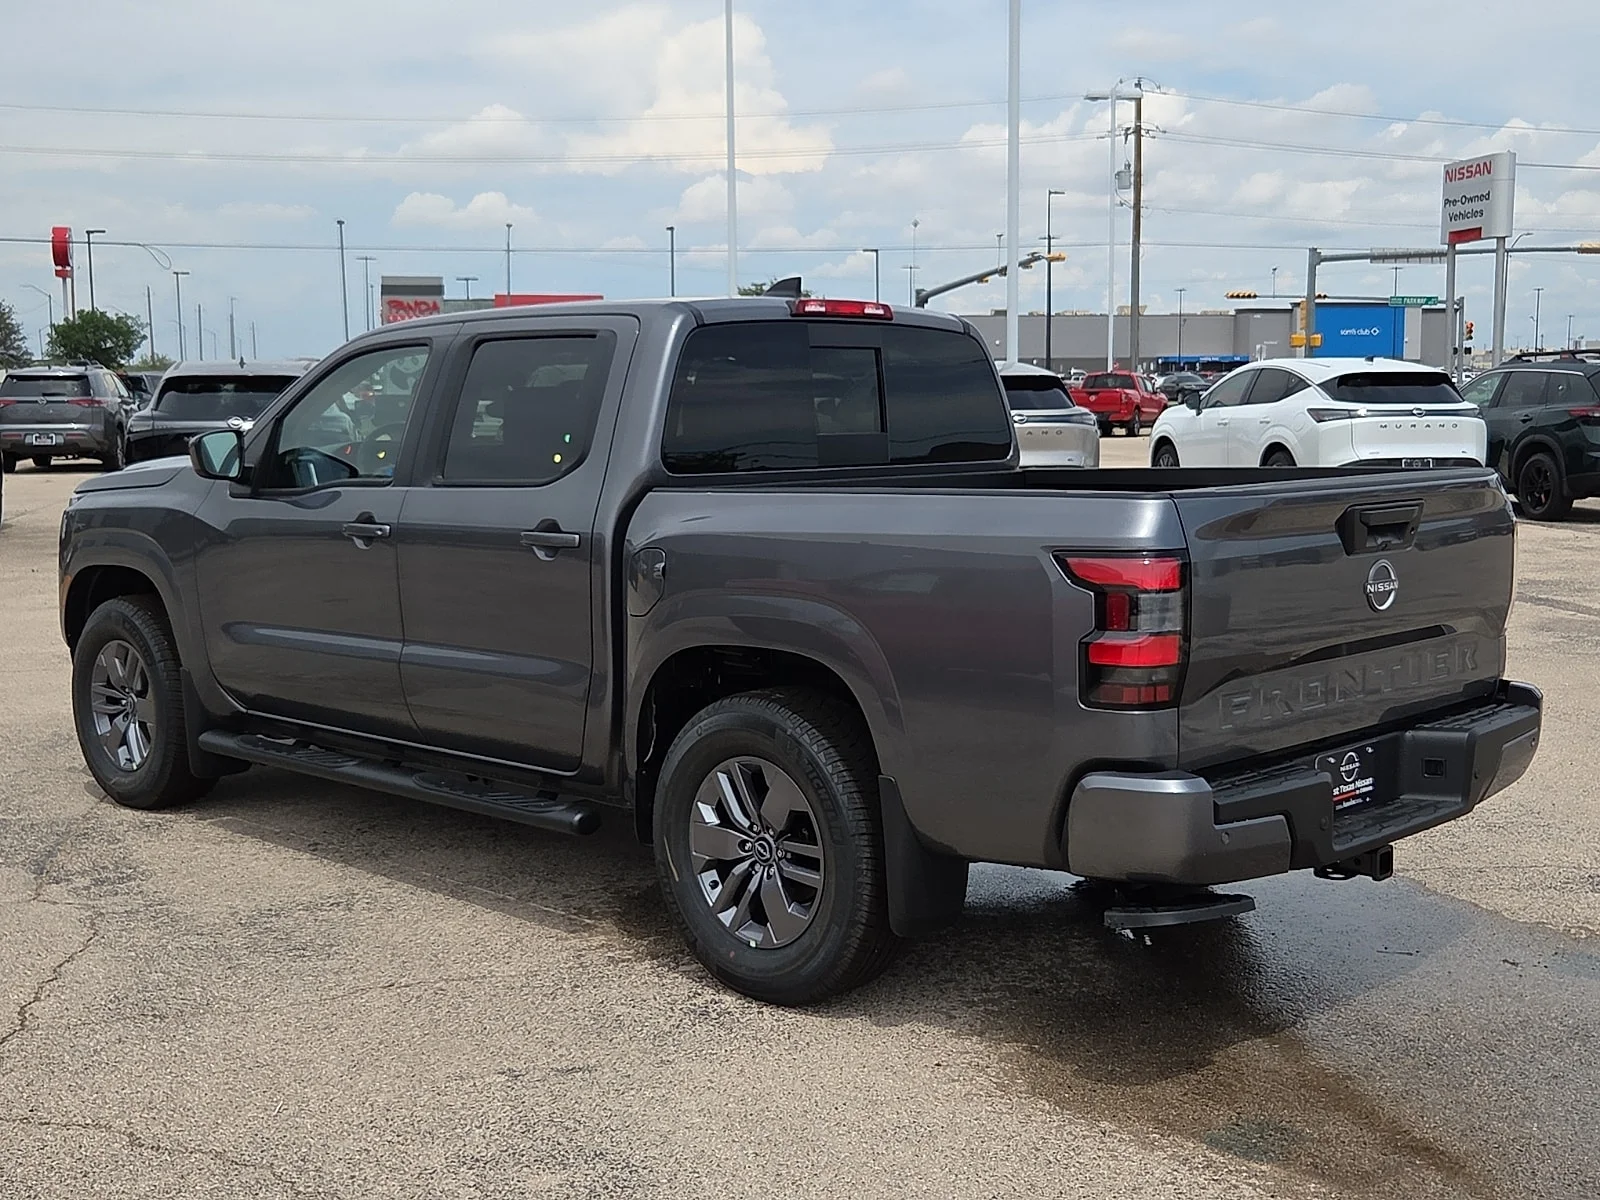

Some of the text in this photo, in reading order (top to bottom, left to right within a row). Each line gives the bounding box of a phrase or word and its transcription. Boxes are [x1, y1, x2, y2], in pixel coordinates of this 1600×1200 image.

[1445, 160, 1492, 183] NISSAN
[1444, 190, 1490, 208] Pre-Owned
[1448, 208, 1484, 223] Vehicles
[387, 299, 440, 319] PANDA
[1357, 328, 1370, 336] club
[1366, 580, 1398, 593] NISSAN
[1219, 640, 1479, 729] FRONTIER
[1355, 777, 1373, 788] Nissan
